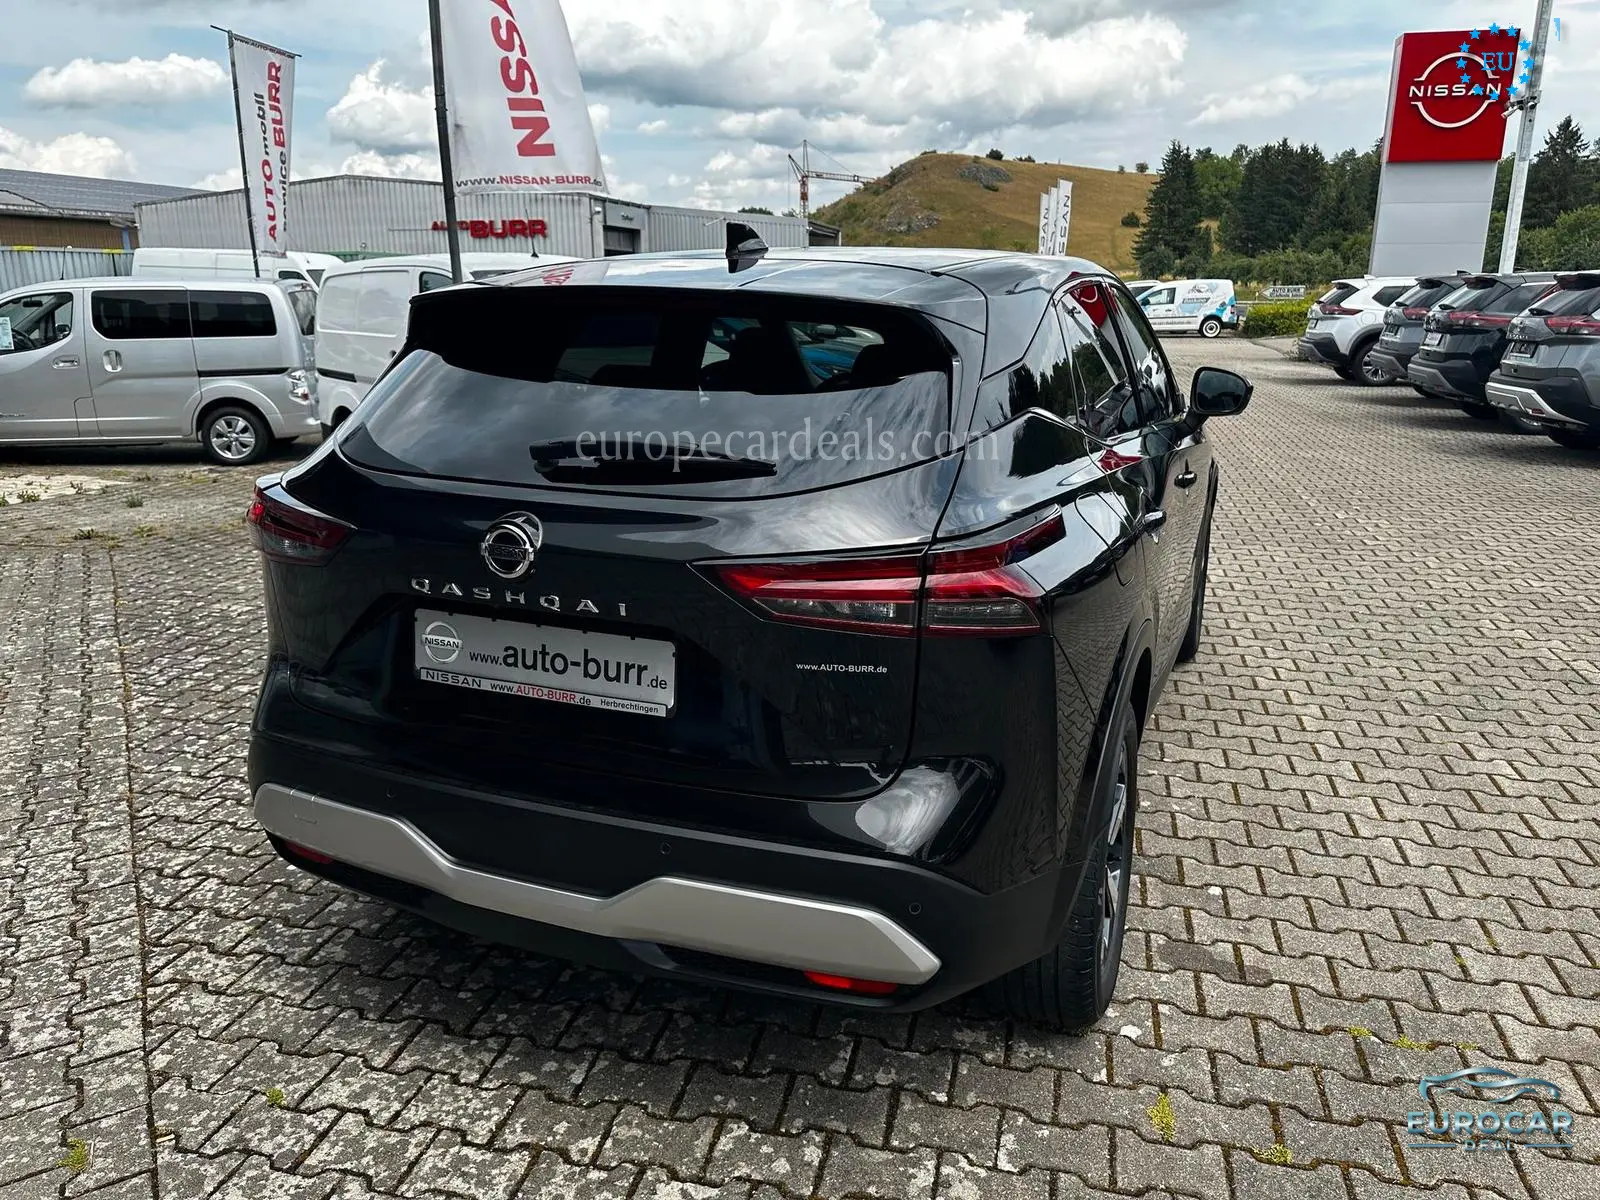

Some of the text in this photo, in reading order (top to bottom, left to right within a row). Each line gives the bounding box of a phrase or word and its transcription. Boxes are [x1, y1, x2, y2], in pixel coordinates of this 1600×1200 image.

[267, 61, 286, 148] BURR
[469, 219, 549, 238] BURR
[411, 577, 627, 617] QASHQAI
[424, 636, 460, 649] NISSAN
[425, 669, 482, 689] NISSAN
[469, 643, 668, 690] www.auto-burr.de
[795, 663, 888, 673] www.AUTO-BURR.de
[489, 681, 659, 714] www.AUTO-BURR.de Herbrechtingen
